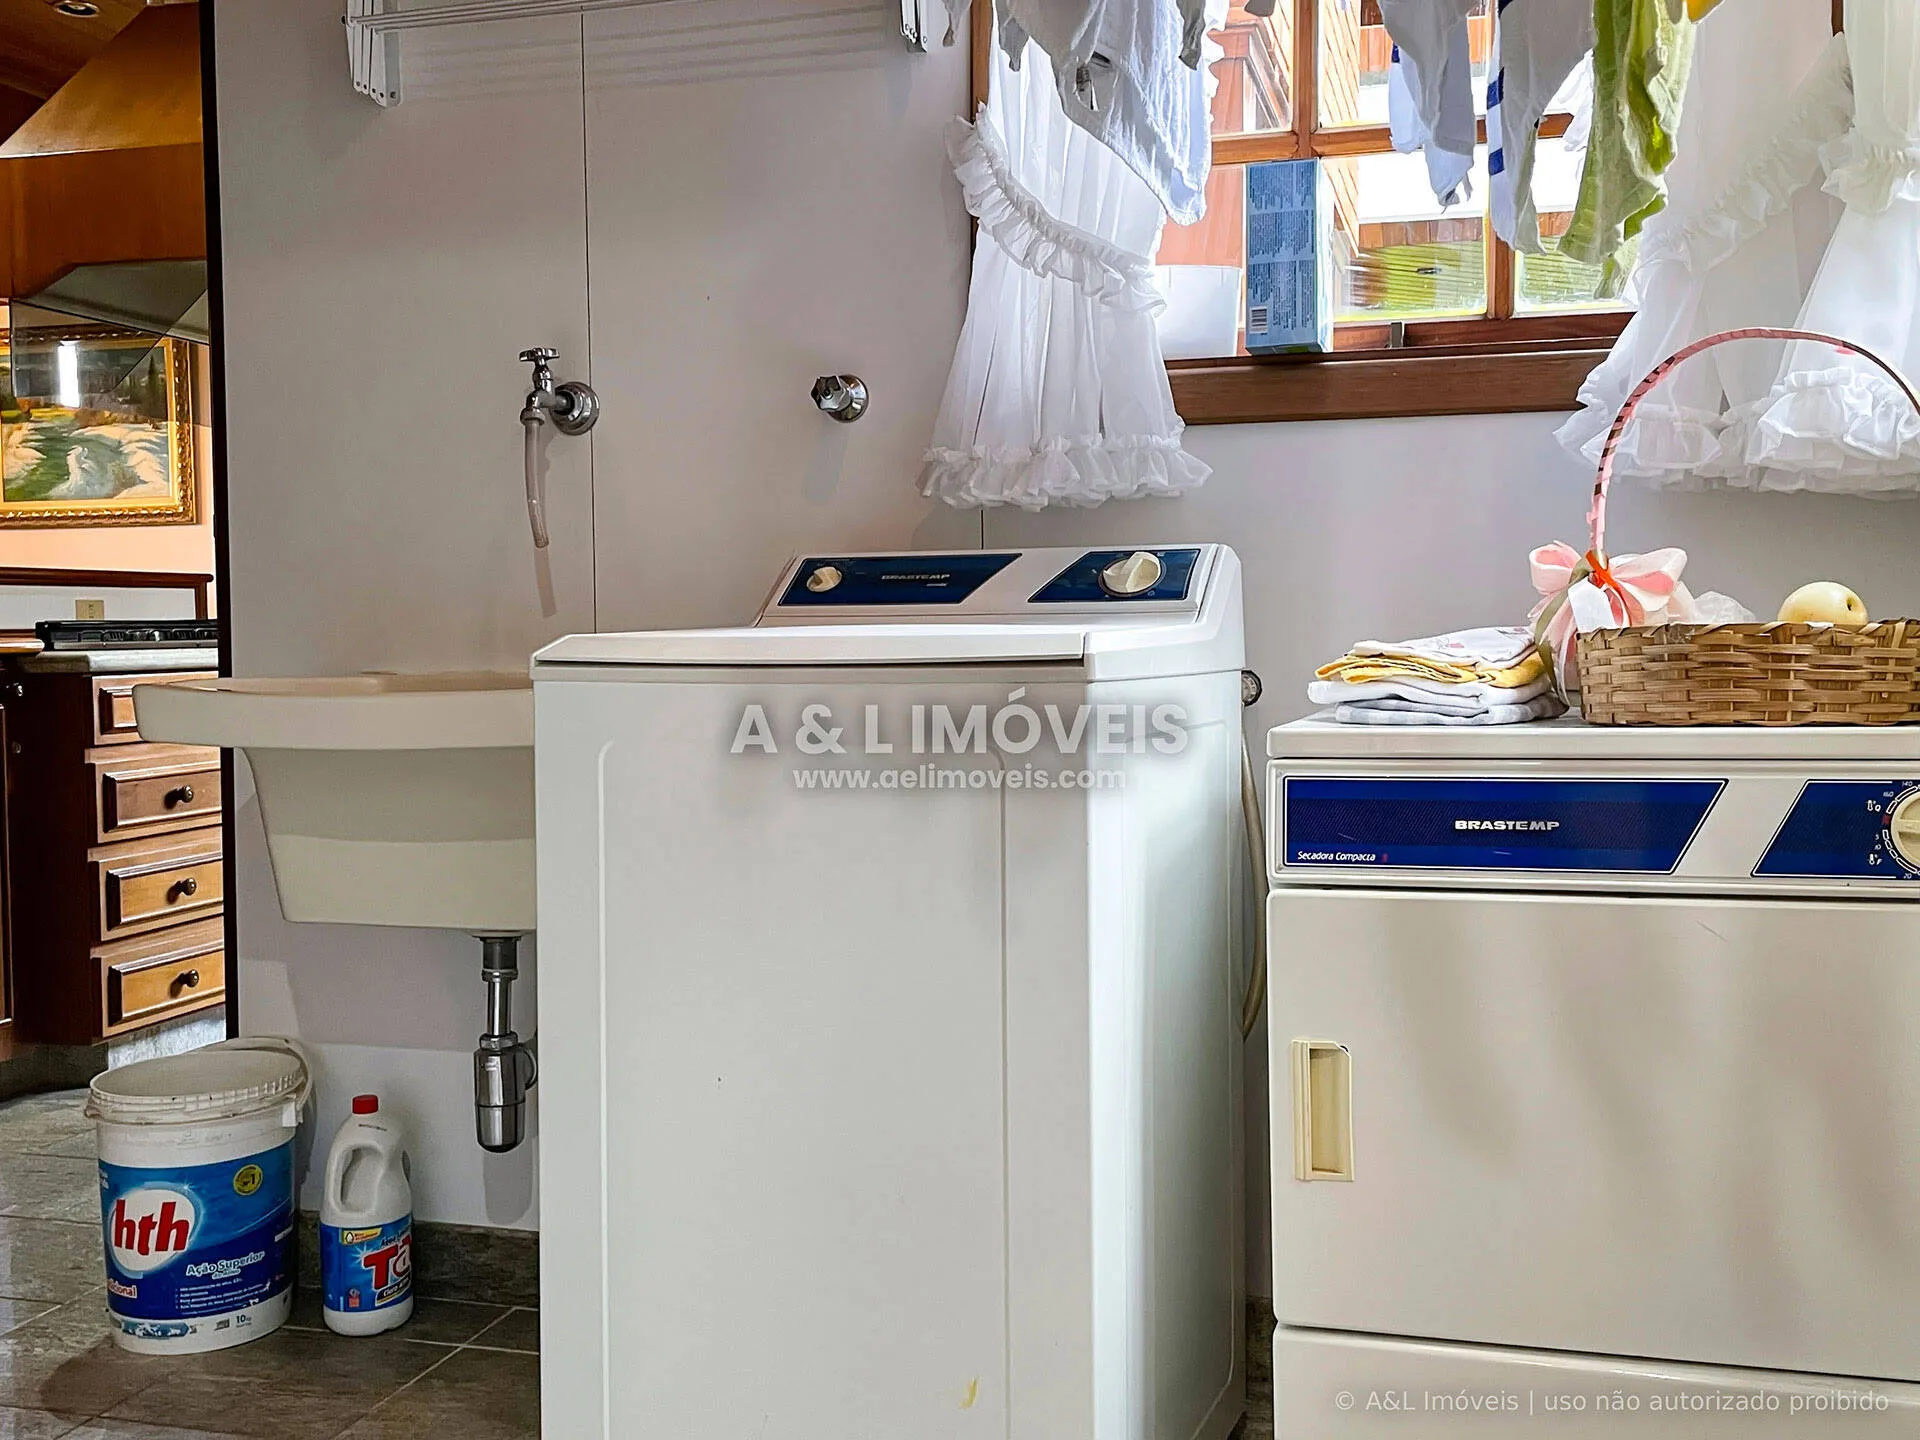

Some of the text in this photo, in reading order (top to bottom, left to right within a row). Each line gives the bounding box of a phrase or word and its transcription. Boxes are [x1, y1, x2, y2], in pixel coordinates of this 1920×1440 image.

[1454, 819, 1561, 832] BRASTEMP
[1297, 850, 1334, 861] Secadora
[1335, 852, 1376, 862] Compacta
[114, 1199, 190, 1256] hth
[186, 1262, 217, 1277] Ação
[217, 1251, 266, 1271] Superior
